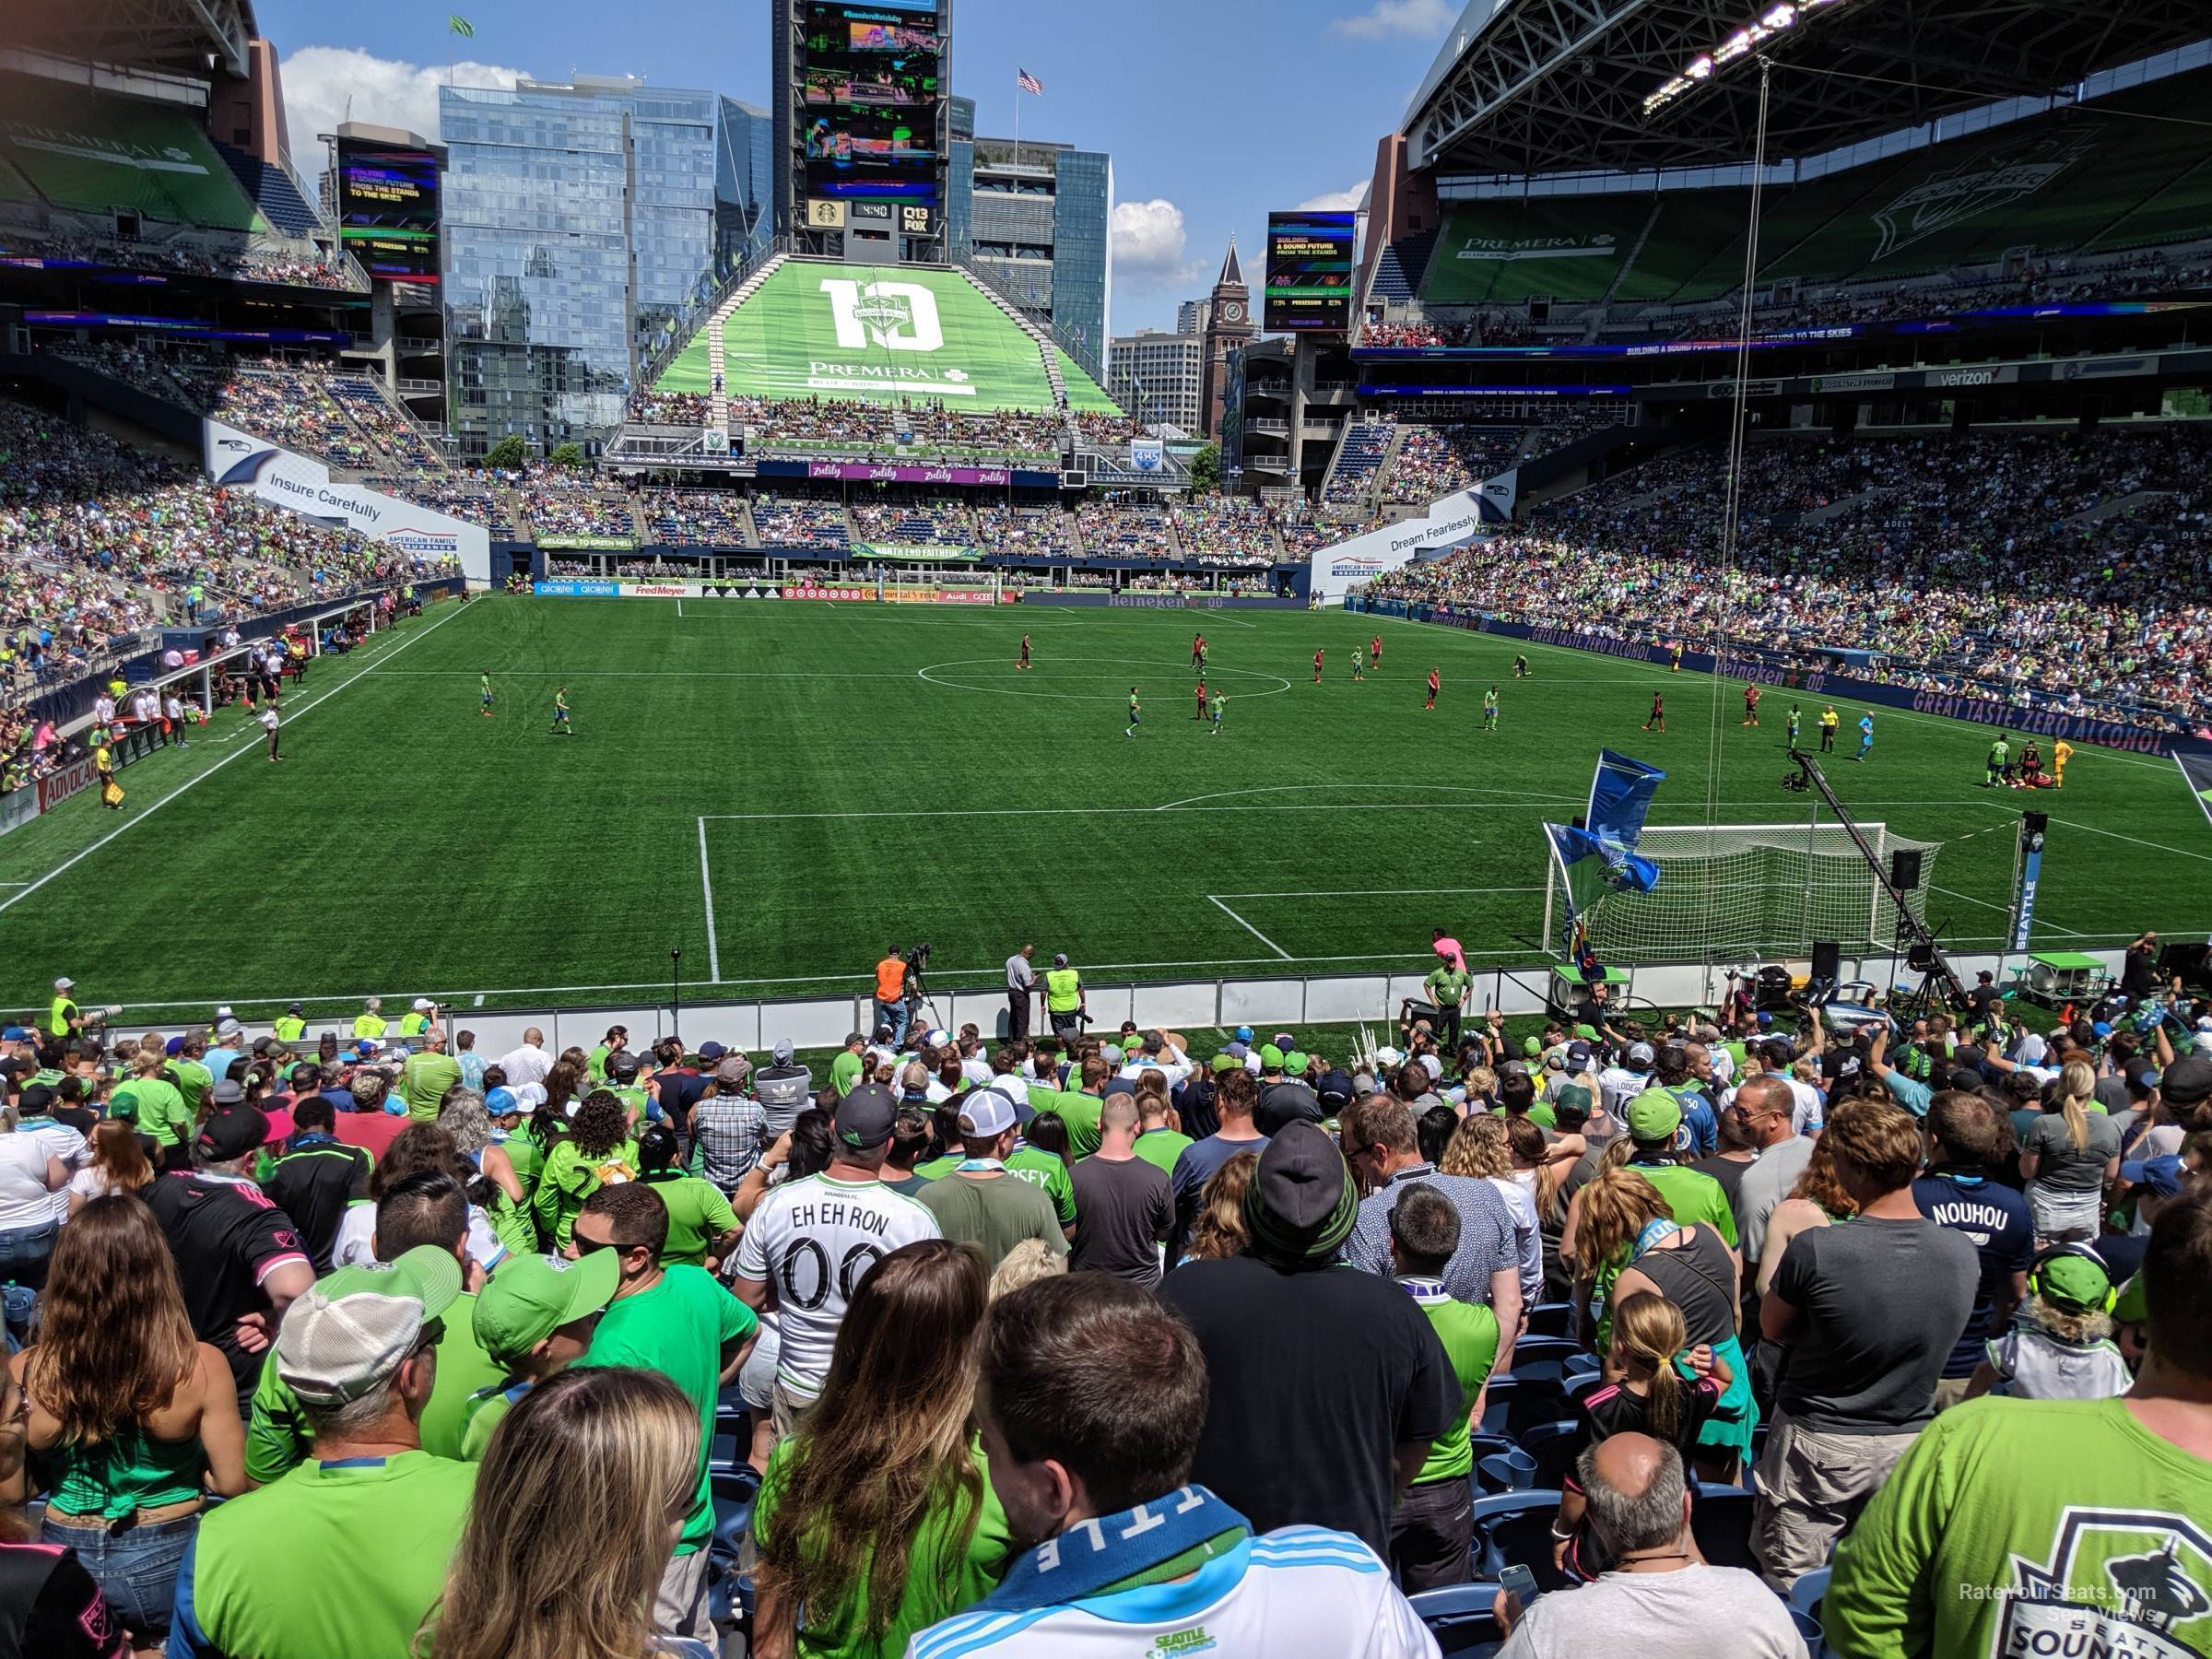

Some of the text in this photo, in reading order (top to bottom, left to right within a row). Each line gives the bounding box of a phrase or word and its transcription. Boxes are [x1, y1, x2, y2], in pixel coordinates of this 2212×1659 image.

[364, 191, 378, 199] THE
[380, 193, 402, 202] SKIES
[375, 184, 389, 194] THE
[391, 187, 419, 197] STANDS
[863, 206, 887, 217] 4:40
[903, 207, 928, 220] Q13
[905, 219, 927, 231] FOX
[1464, 237, 1577, 249] PREMERA
[819, 278, 944, 351] 10
[1627, 346, 1659, 355] BUILDING
[1661, 345, 1666, 353] A
[1667, 344, 1691, 353] SOUND
[1796, 332, 1807, 340] TO
[1809, 330, 1826, 339] THE
[1827, 328, 1853, 338] SKIES
[808, 361, 931, 380] PREMERA
[1940, 371, 1993, 386] verizon
[1136, 451, 1159, 462] 485
[270, 473, 381, 522] Insure Carefully
[1891, 520, 1912, 528] DELT
[389, 535, 428, 544] AMERICAN
[1391, 514, 1477, 552] Dream Fearlessly
[540, 538, 577, 547] WELCOME
[590, 538, 615, 547] GREEN
[876, 547, 959, 557] NORTH END FAITHFUL
[541, 585, 574, 594] alcatel
[581, 585, 614, 594] alcatel
[865, 590, 911, 599] Connental
[1109, 594, 1185, 607] Heineken
[1430, 612, 1468, 629] Heineken
[1532, 627, 1652, 662] GREAT TASTE. ZERO ALCOHOL.
[1712, 661, 1785, 686] Heineken
[1913, 692, 2169, 757] GREAT TASTE. ZERO ALCOHOL.
[47, 759, 100, 806] ADVOCAR
[2016, 880, 2036, 950] SEATTLE
[1616, 1082, 1641, 1094] LODEIR
[824, 1191, 851, 1199] SOUNDERS
[792, 1203, 890, 1237] EH EH RON
[1932, 1202, 2008, 1230] NOUHOU
[1037, 1483, 1216, 1574] TTLE
[1155, 1625, 1205, 1648] SEATTLE
